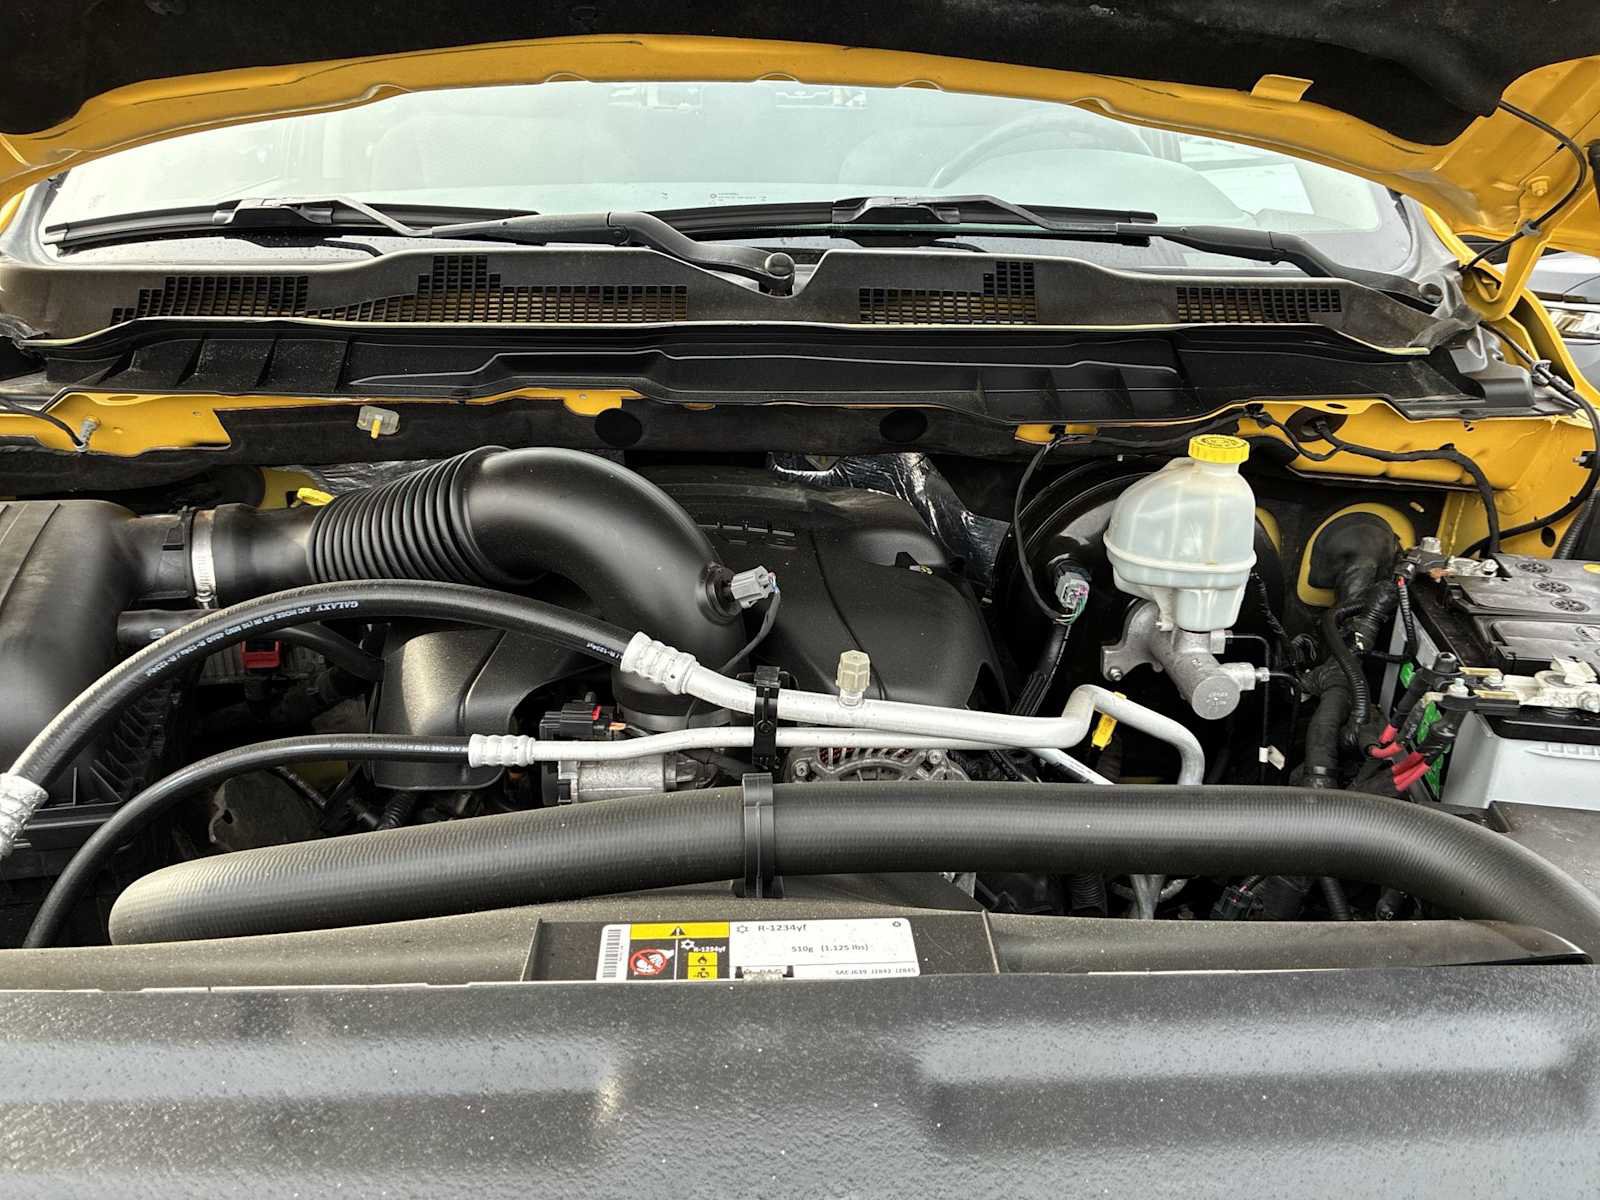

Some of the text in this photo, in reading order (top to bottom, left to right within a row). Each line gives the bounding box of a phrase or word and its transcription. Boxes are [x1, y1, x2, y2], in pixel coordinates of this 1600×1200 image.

[315, 600, 360, 612] GALAXY
[275, 609, 298, 620] HOSE
[757, 924, 807, 933] R-1234yf
[693, 945, 727, 954] R-1234yf
[791, 943, 869, 953] 510g (1.125 lbs)
